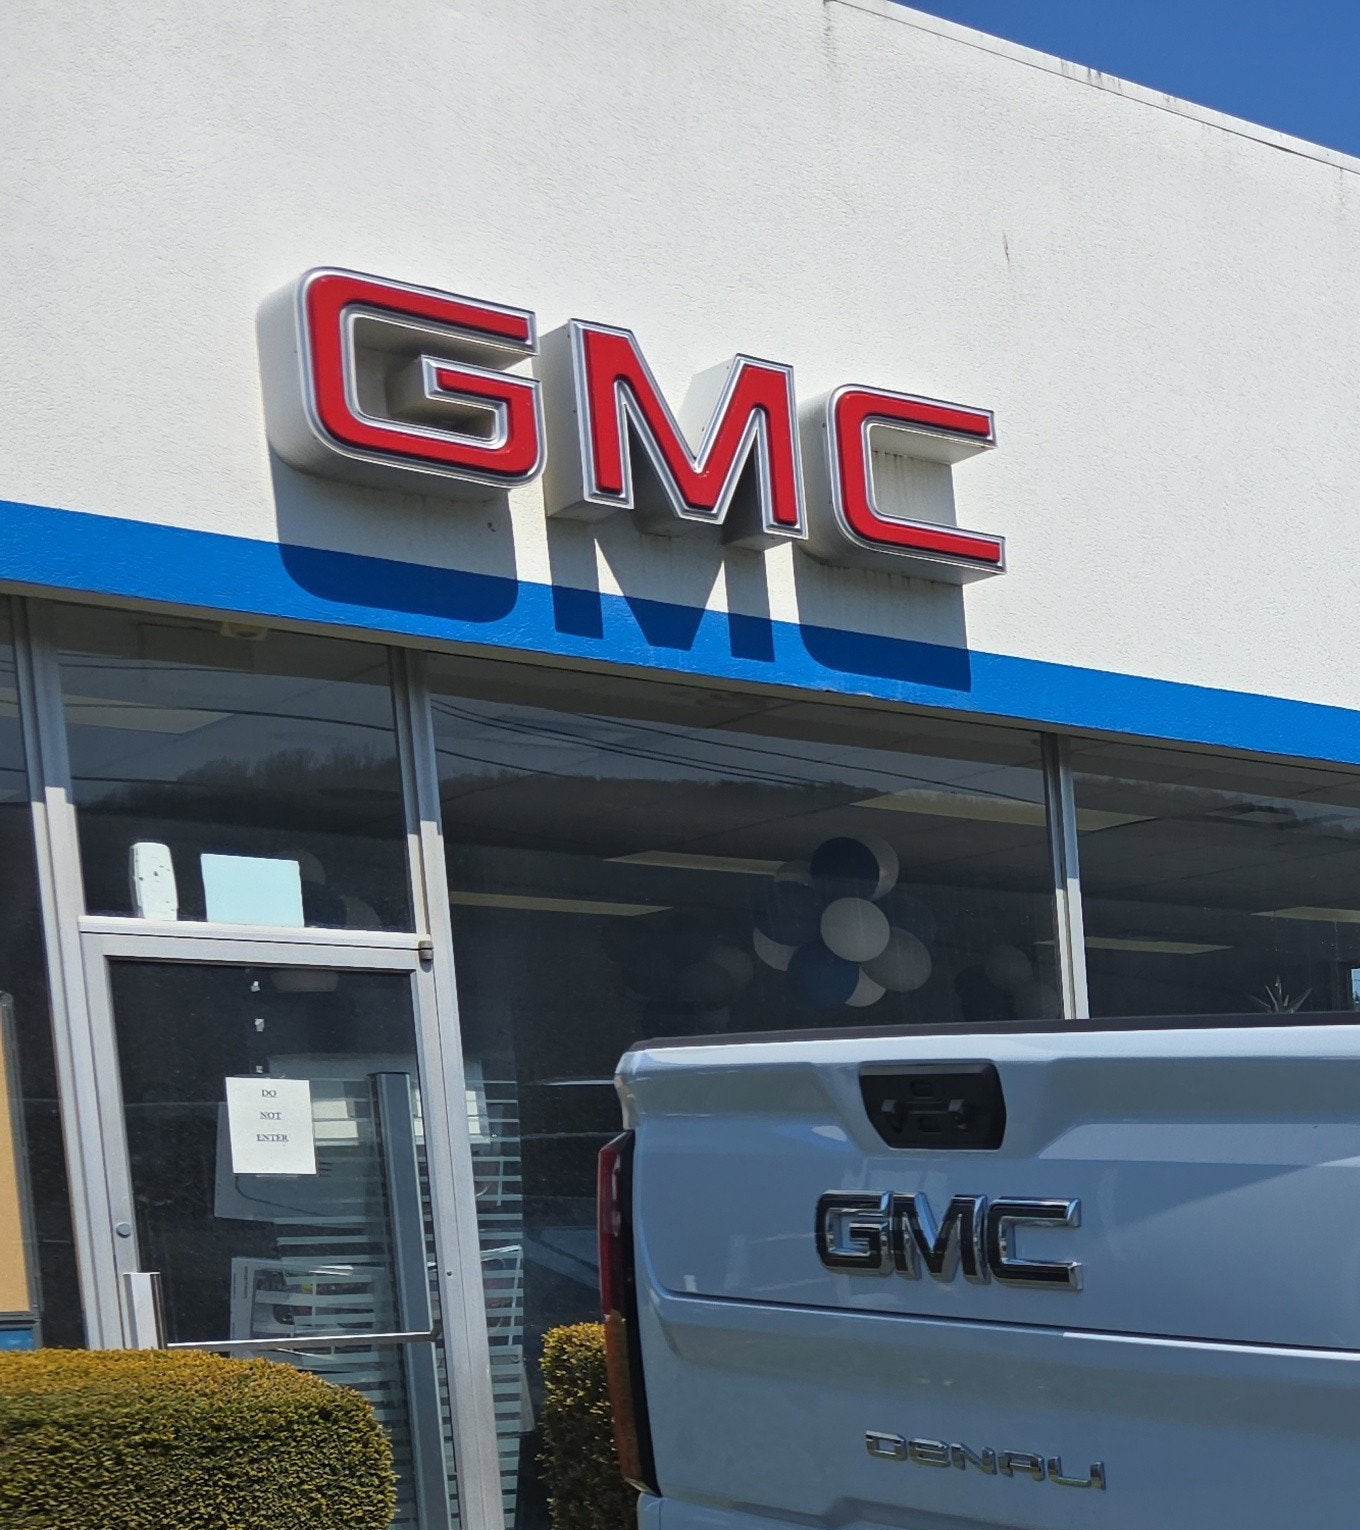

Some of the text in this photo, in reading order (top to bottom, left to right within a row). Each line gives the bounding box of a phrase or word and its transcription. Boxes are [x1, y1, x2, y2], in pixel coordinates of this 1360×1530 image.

[296, 266, 1007, 576] GMC
[261, 1089, 278, 1098] DO
[259, 1111, 283, 1120] NOT
[255, 1133, 290, 1143] ENTER
[815, 1189, 1083, 1291] GMC
[864, 1429, 1107, 1491] DENALI
